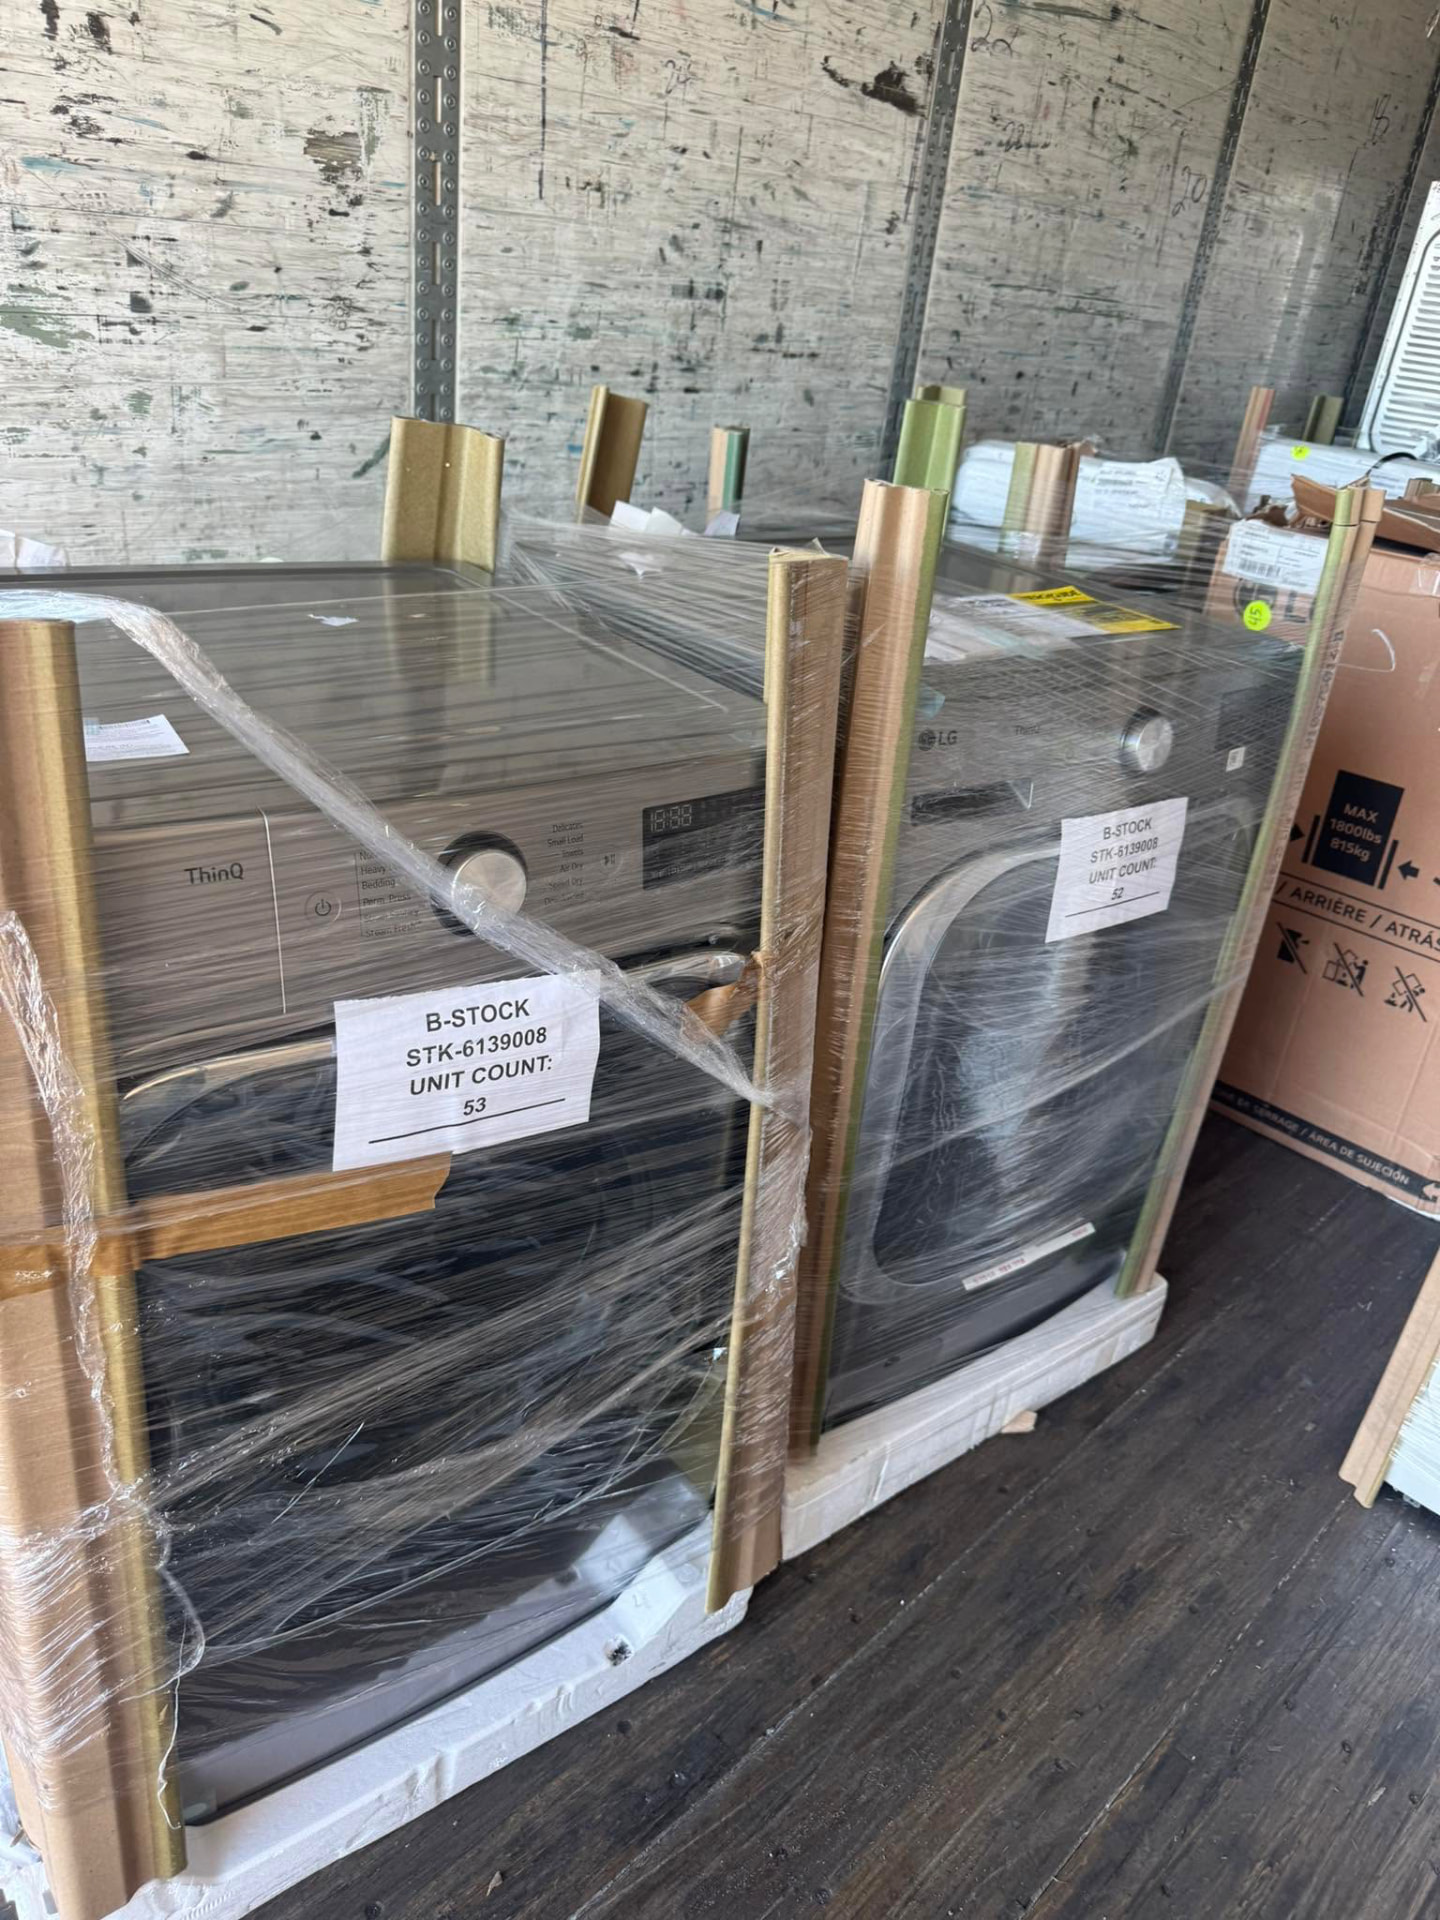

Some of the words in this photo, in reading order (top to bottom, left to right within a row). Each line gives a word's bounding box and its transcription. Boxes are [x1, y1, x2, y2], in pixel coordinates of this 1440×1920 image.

[938, 730, 958, 746] LG
[1343, 803, 1380, 824] MAX
[1103, 817, 1153, 840] B-STOCK
[1330, 817, 1383, 845] 1800lbs
[1090, 837, 1159, 864] STK-6139008
[1330, 837, 1371, 863] 815kg
[184, 862, 245, 885] ThinQ
[361, 879, 395, 890] Bedding
[1088, 867, 1117, 884] UNIT
[1111, 887, 1125, 901] 52
[426, 999, 530, 1033] B-STOCK
[406, 1027, 547, 1067] STK-6139008
[410, 1070, 465, 1096] UNIT
[471, 1054, 553, 1085] COUNT:
[463, 1097, 487, 1116] 53
[1339, 1145, 1355, 1160] DE
[1356, 1152, 1410, 1186] SUJECIÓN
